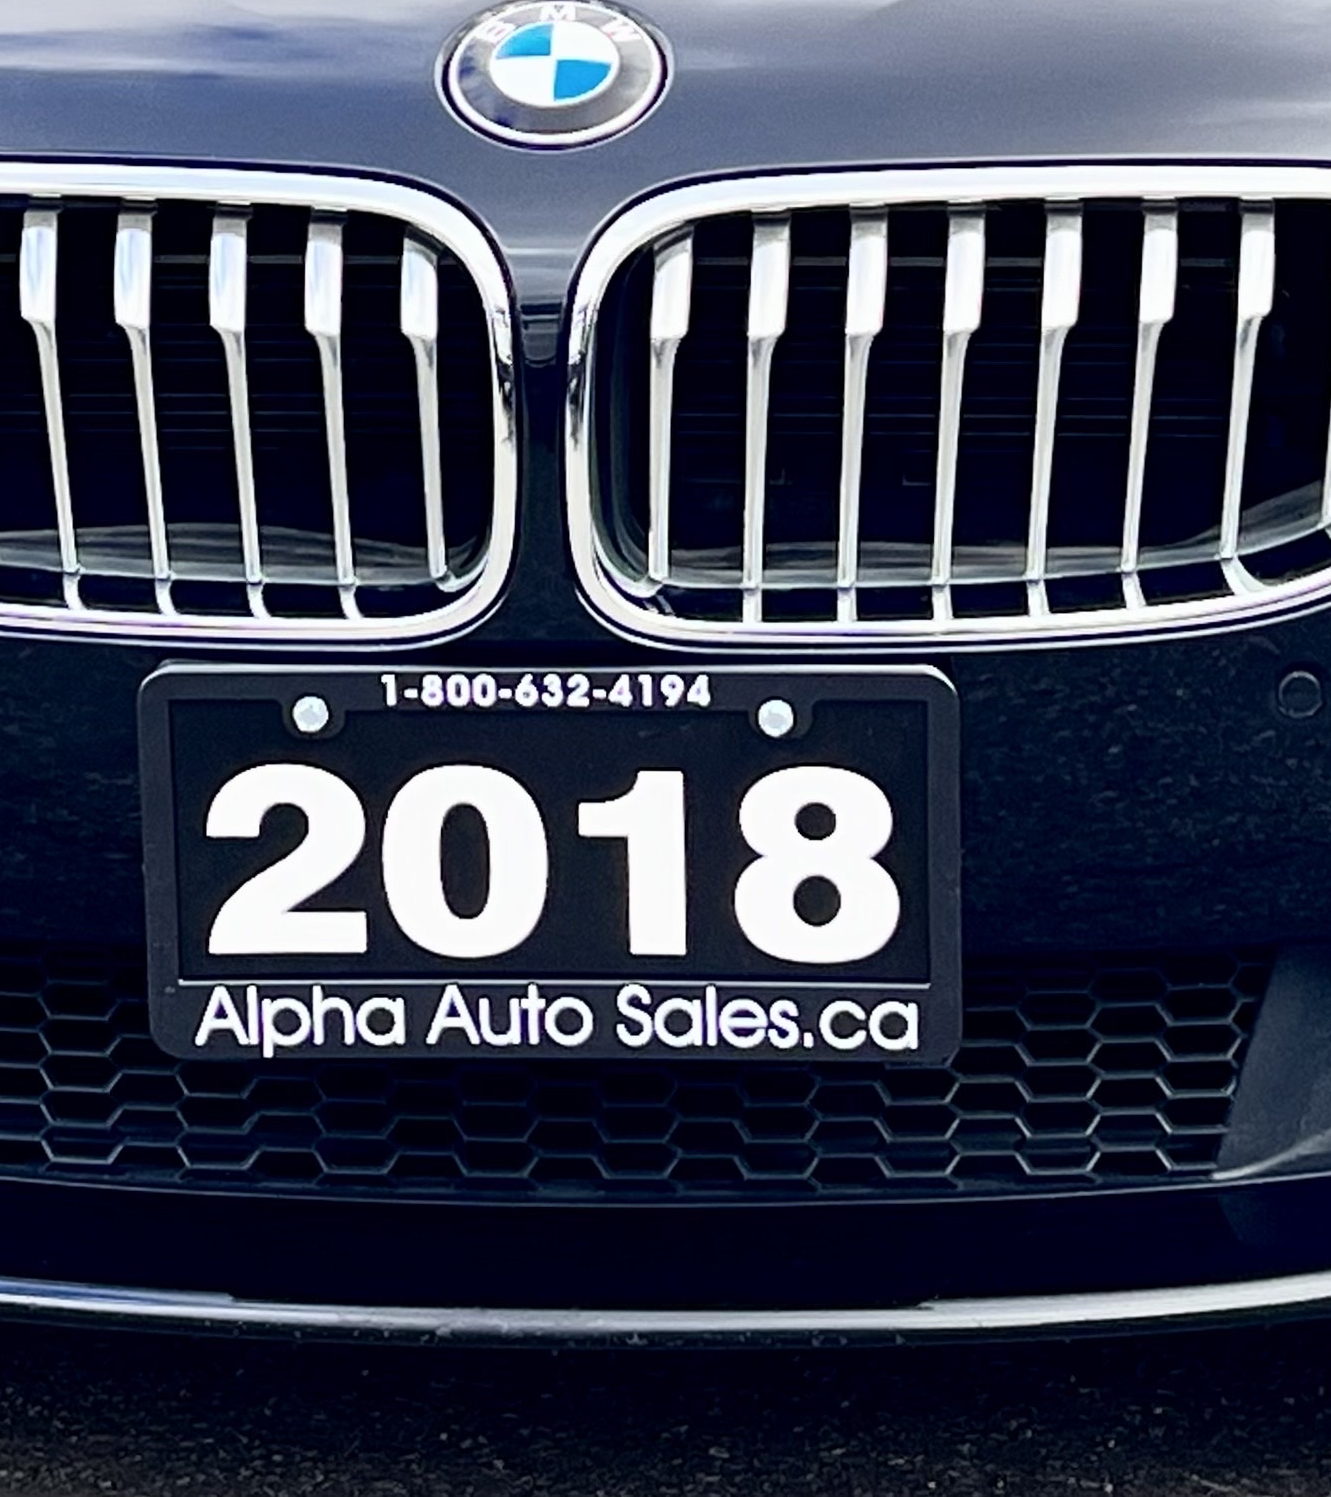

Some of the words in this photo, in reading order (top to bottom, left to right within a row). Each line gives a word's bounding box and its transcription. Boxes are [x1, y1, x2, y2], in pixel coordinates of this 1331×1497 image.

[380, 673, 711, 708] 1-800-632-4194
[205, 763, 901, 965] 2018
[194, 985, 406, 1058] Alpha
[427, 984, 596, 1047] Auto
[617, 985, 920, 1050] Sales.ca
